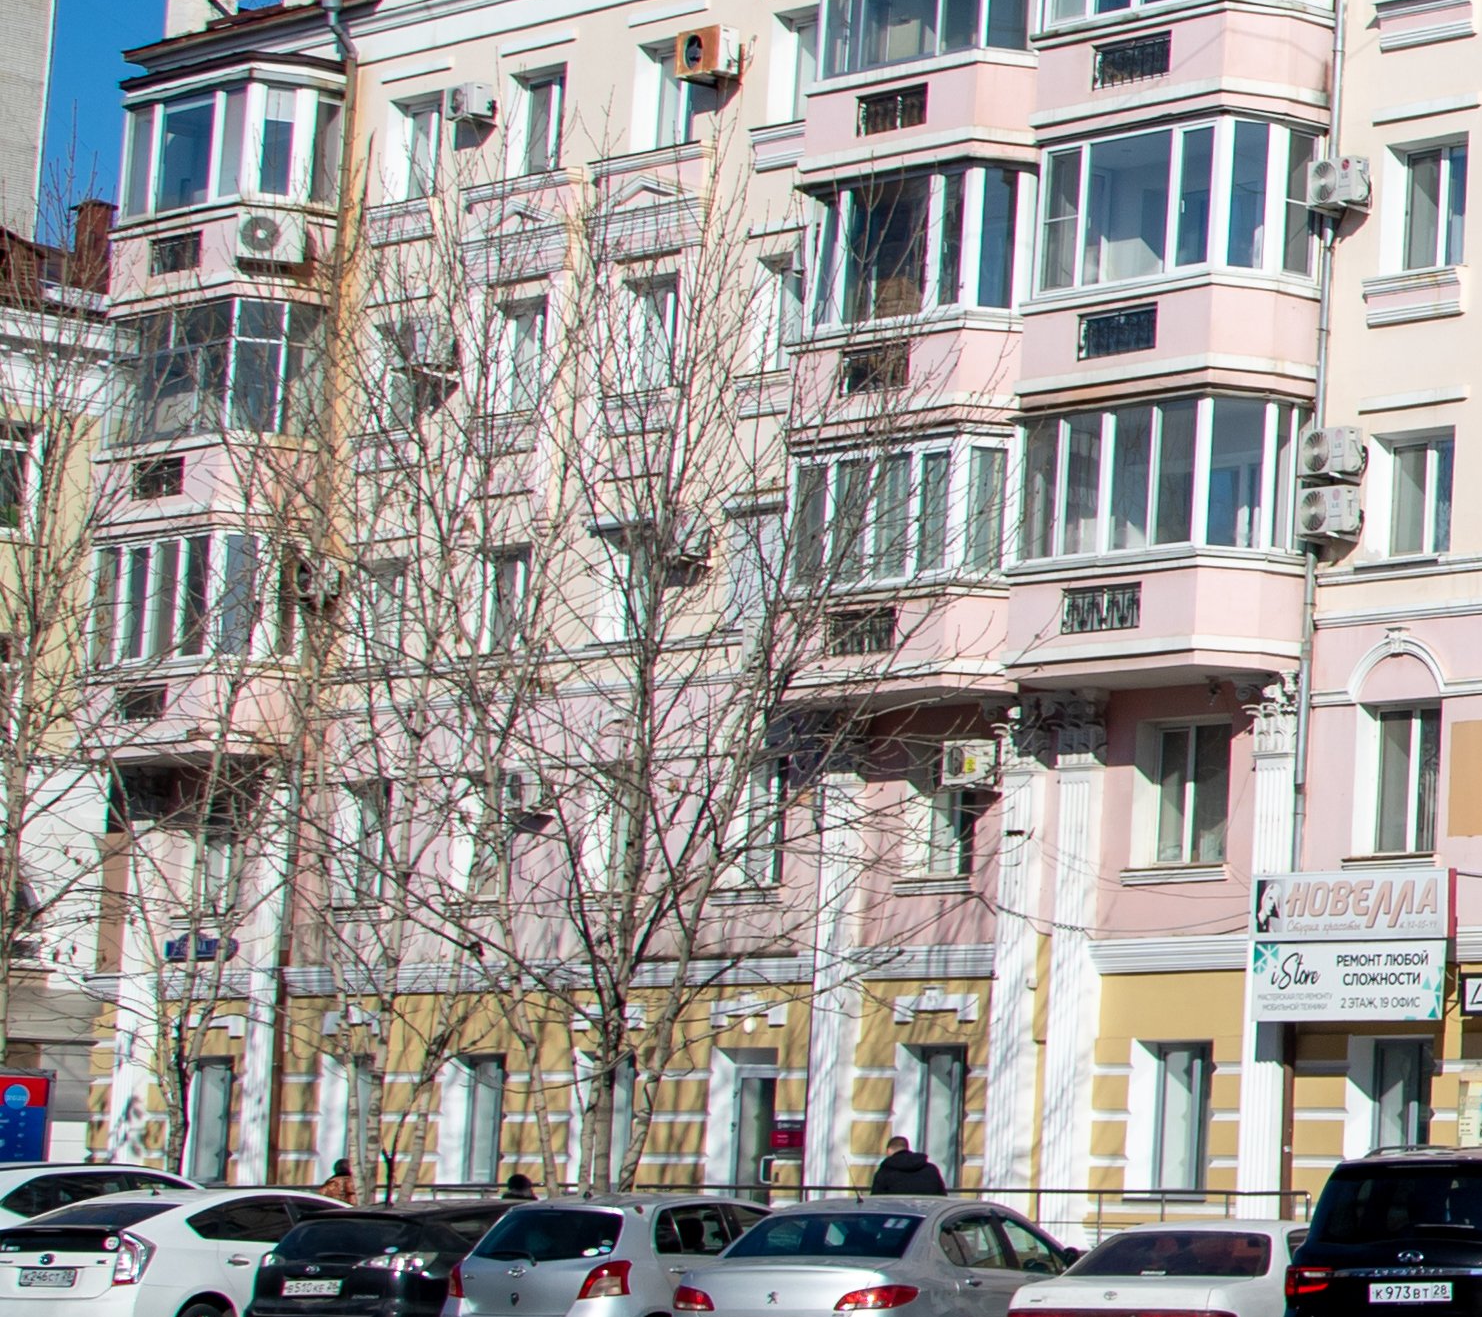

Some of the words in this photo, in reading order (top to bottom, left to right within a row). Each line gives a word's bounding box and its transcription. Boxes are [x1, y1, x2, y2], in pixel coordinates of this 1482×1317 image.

[1286, 878, 1438, 929] НОВЕЛЛА
[1336, 954, 1383, 967] РЕМОНТ
[1384, 950, 1430, 966] ЛЮБОЙ
[1343, 972, 1421, 986] СЛОЖНОСТИ
[1340, 998, 1346, 1009] 2
[1349, 997, 1377, 1010] ЭТАЖ,
[1379, 997, 1389, 1008] 19
[1392, 996, 1421, 1009] ОФИС
[1375, 1285, 1430, 1300] К973ВТ
[1433, 1285, 1447, 1296] 28
